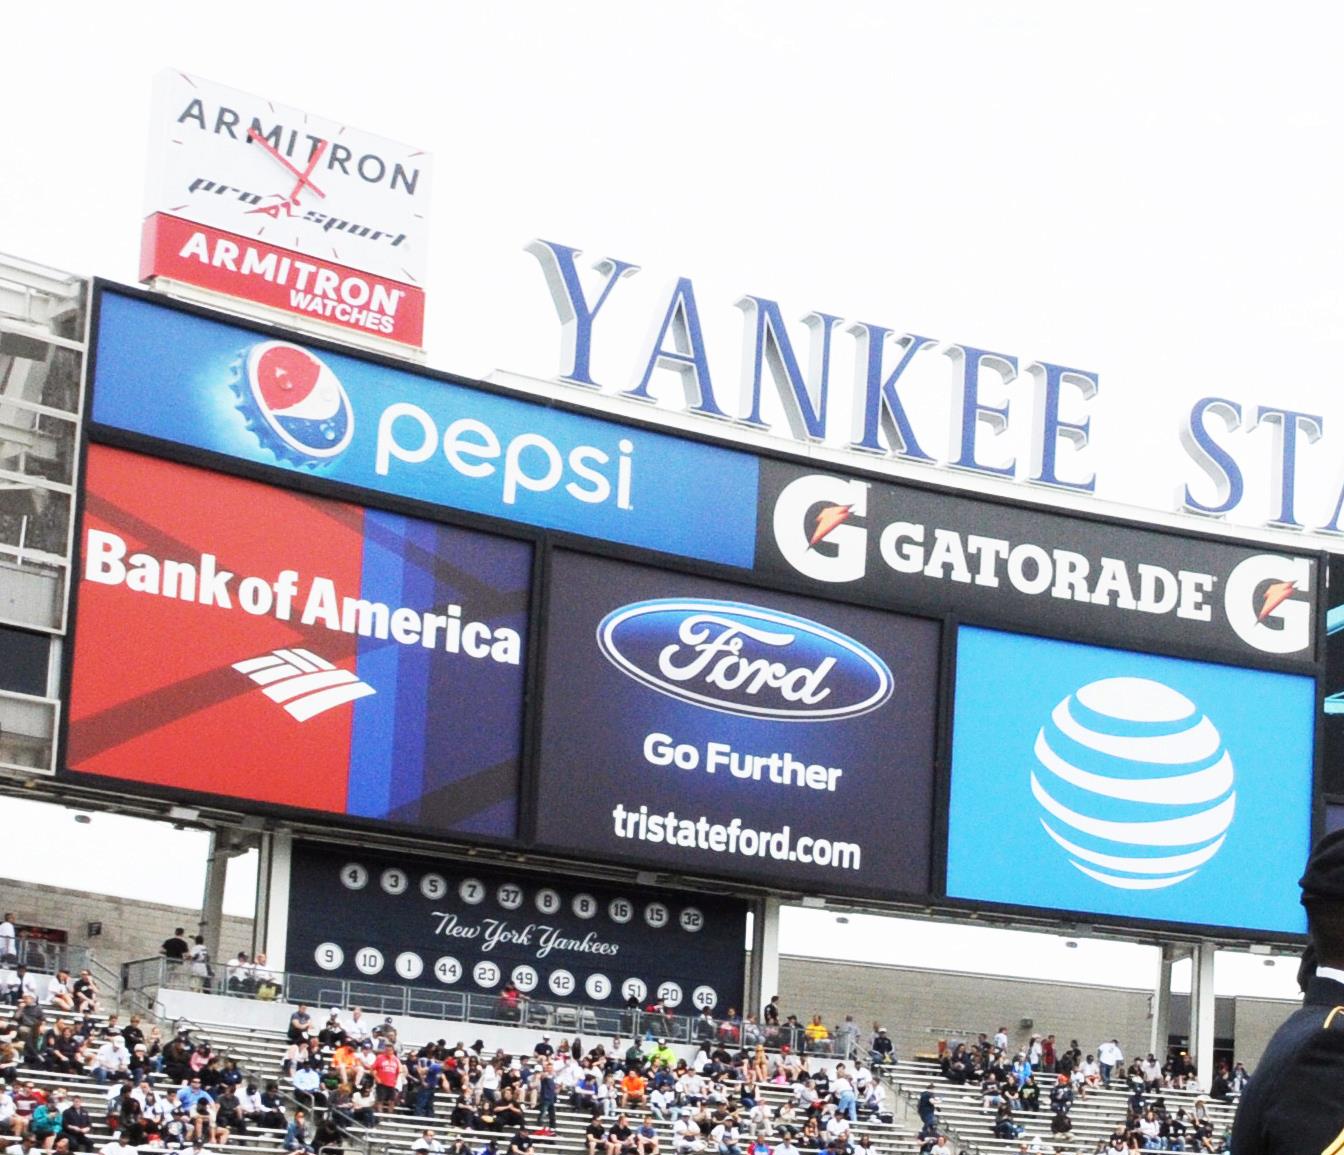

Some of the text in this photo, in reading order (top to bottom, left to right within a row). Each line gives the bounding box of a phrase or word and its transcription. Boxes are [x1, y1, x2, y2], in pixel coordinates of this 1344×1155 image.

[177, 98, 420, 196] ARMITRON
[187, 178, 408, 248] pro sport
[179, 232, 403, 316] ARMITRON
[289, 289, 395, 334] WATCHES
[522, 237, 1100, 494] YANKEE
[374, 402, 634, 511] pepsi
[85, 528, 521, 665] Bank of America
[879, 520, 1214, 622] GATORADE
[658, 612, 838, 707] Ford
[642, 732, 843, 792] Go Further
[612, 803, 861, 870] tristateford.com
[348, 869, 701, 927] 4 3 5 7 37 8 8 16 15 32
[431, 911, 620, 958] New York Yankees
[324, 950, 714, 1006] 9 10 1 44 23 49 42 6 51 20 46
